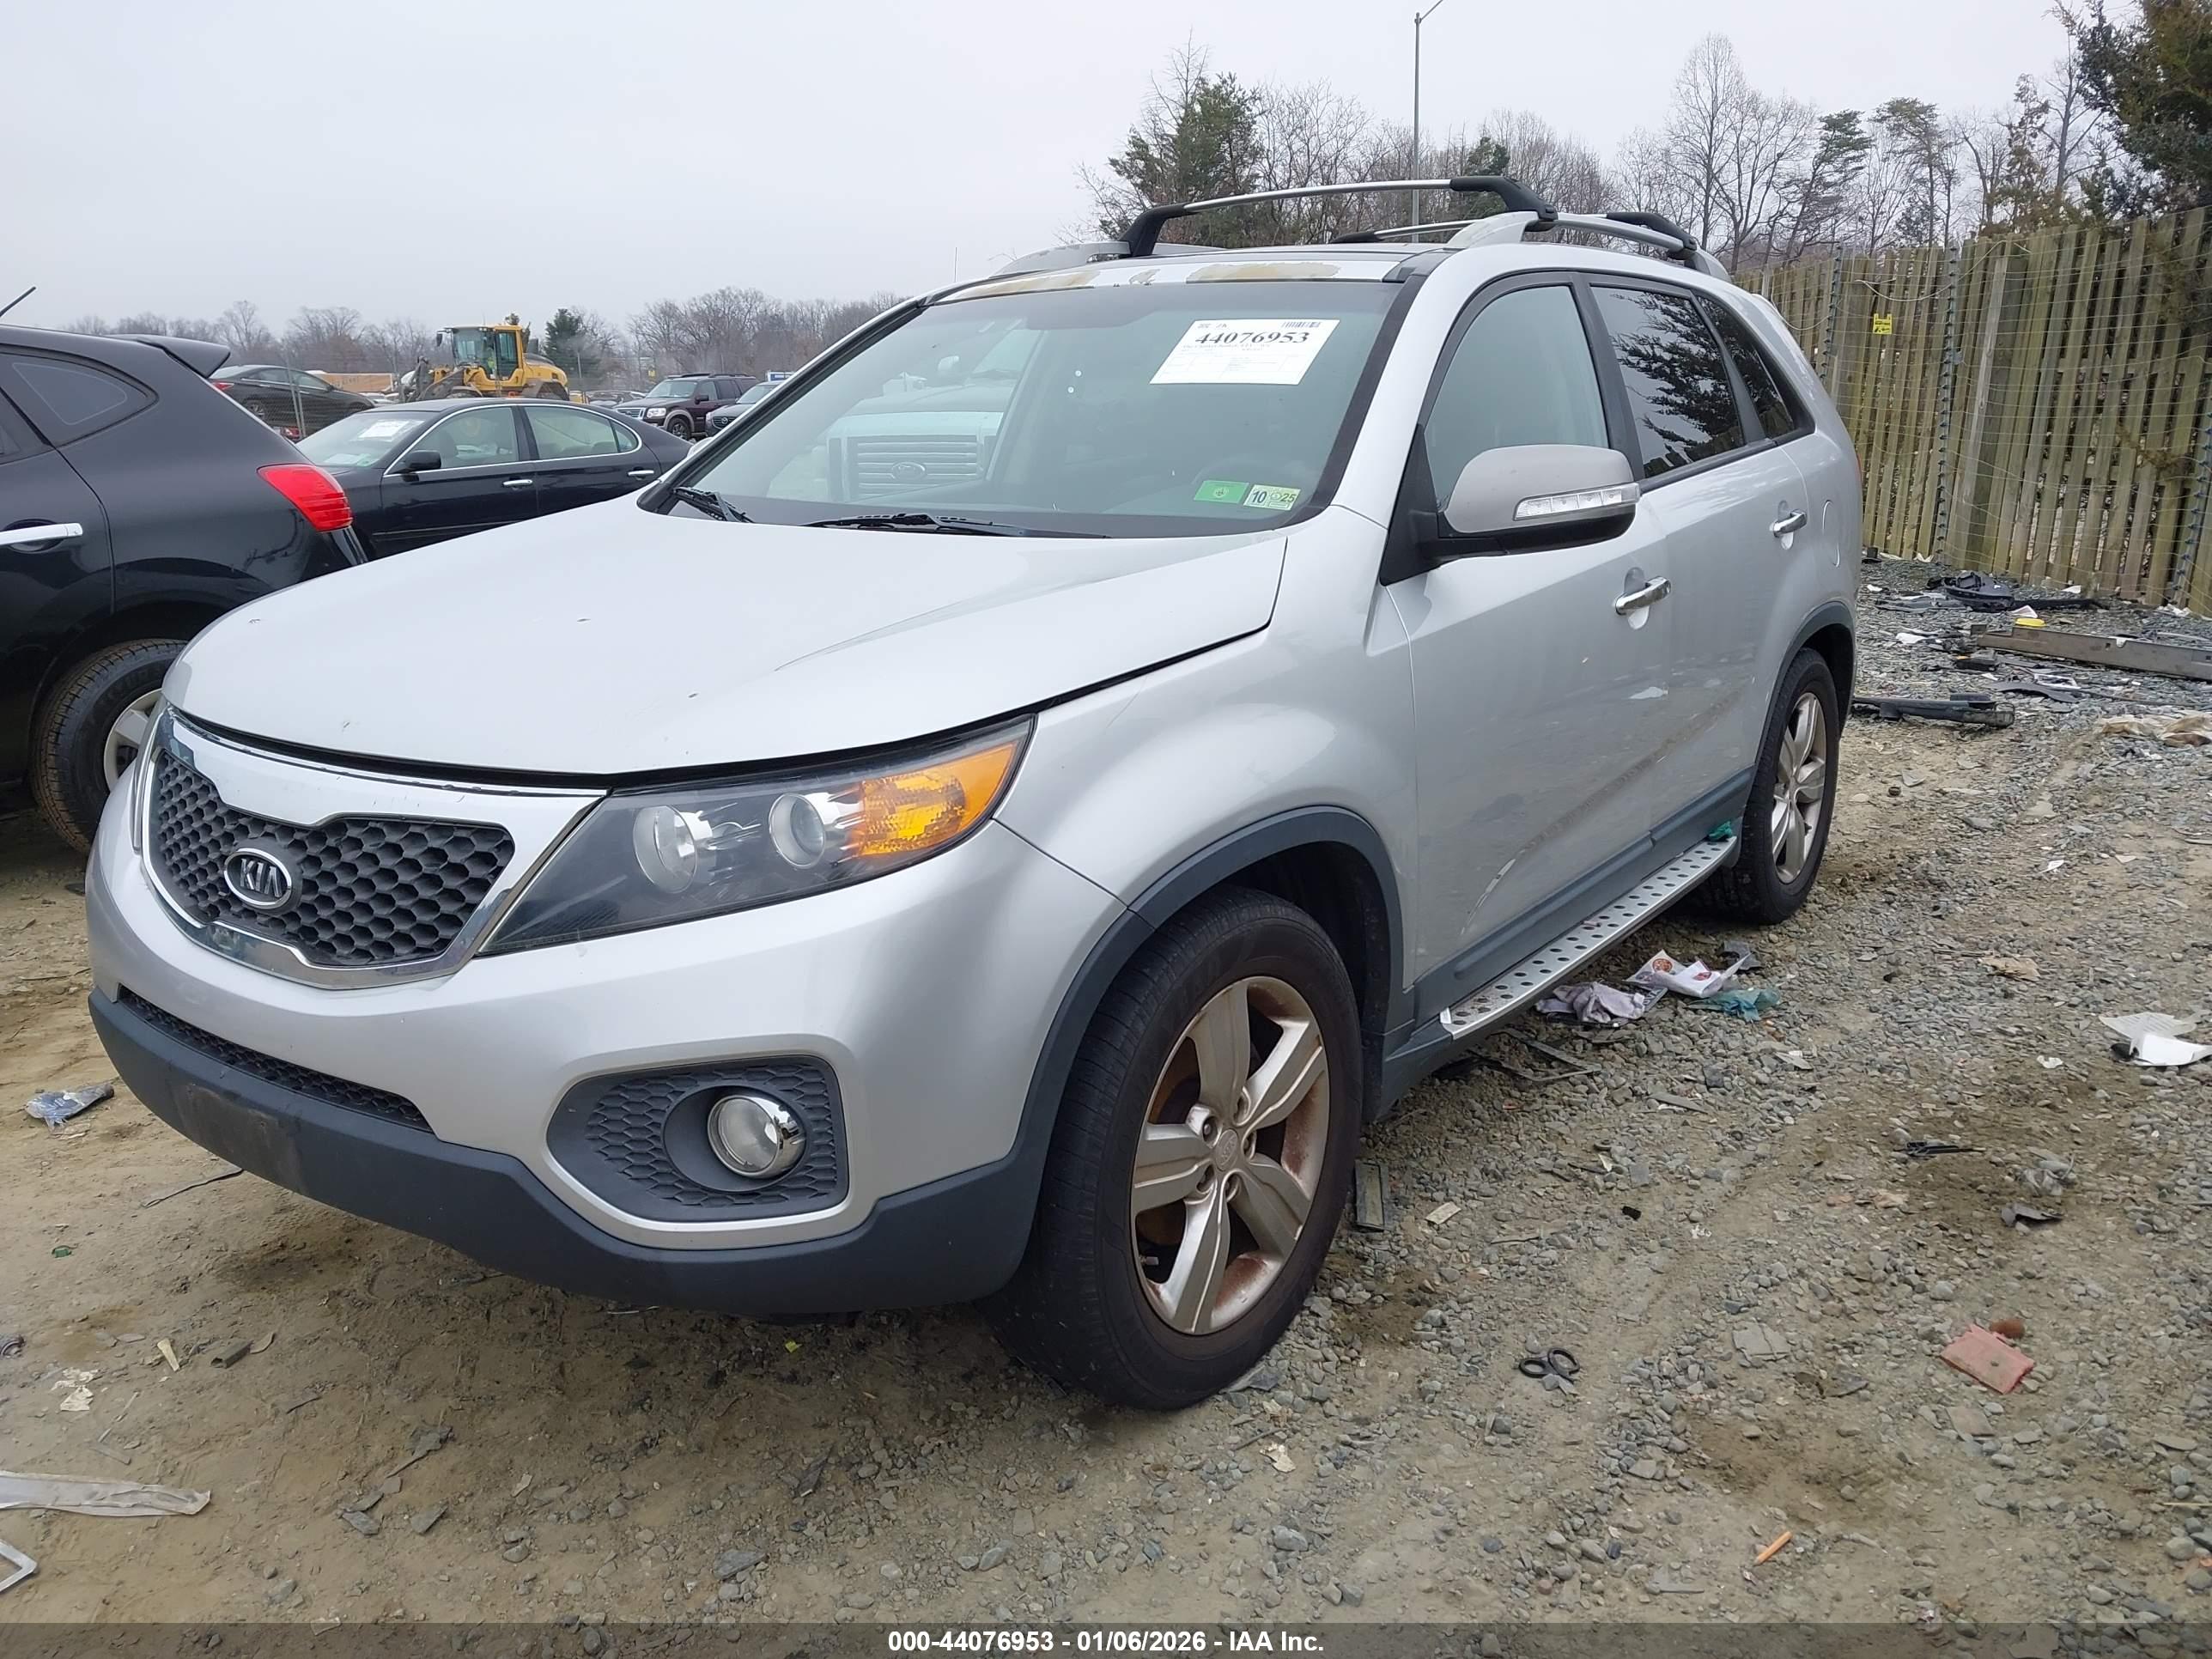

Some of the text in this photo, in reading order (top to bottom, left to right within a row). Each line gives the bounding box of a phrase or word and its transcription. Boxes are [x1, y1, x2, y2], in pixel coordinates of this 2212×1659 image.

[1195, 331, 1310, 344] 44076953
[1252, 490, 1268, 504] 10
[1280, 492, 1296, 503] 25
[240, 858, 283, 898] KIA
